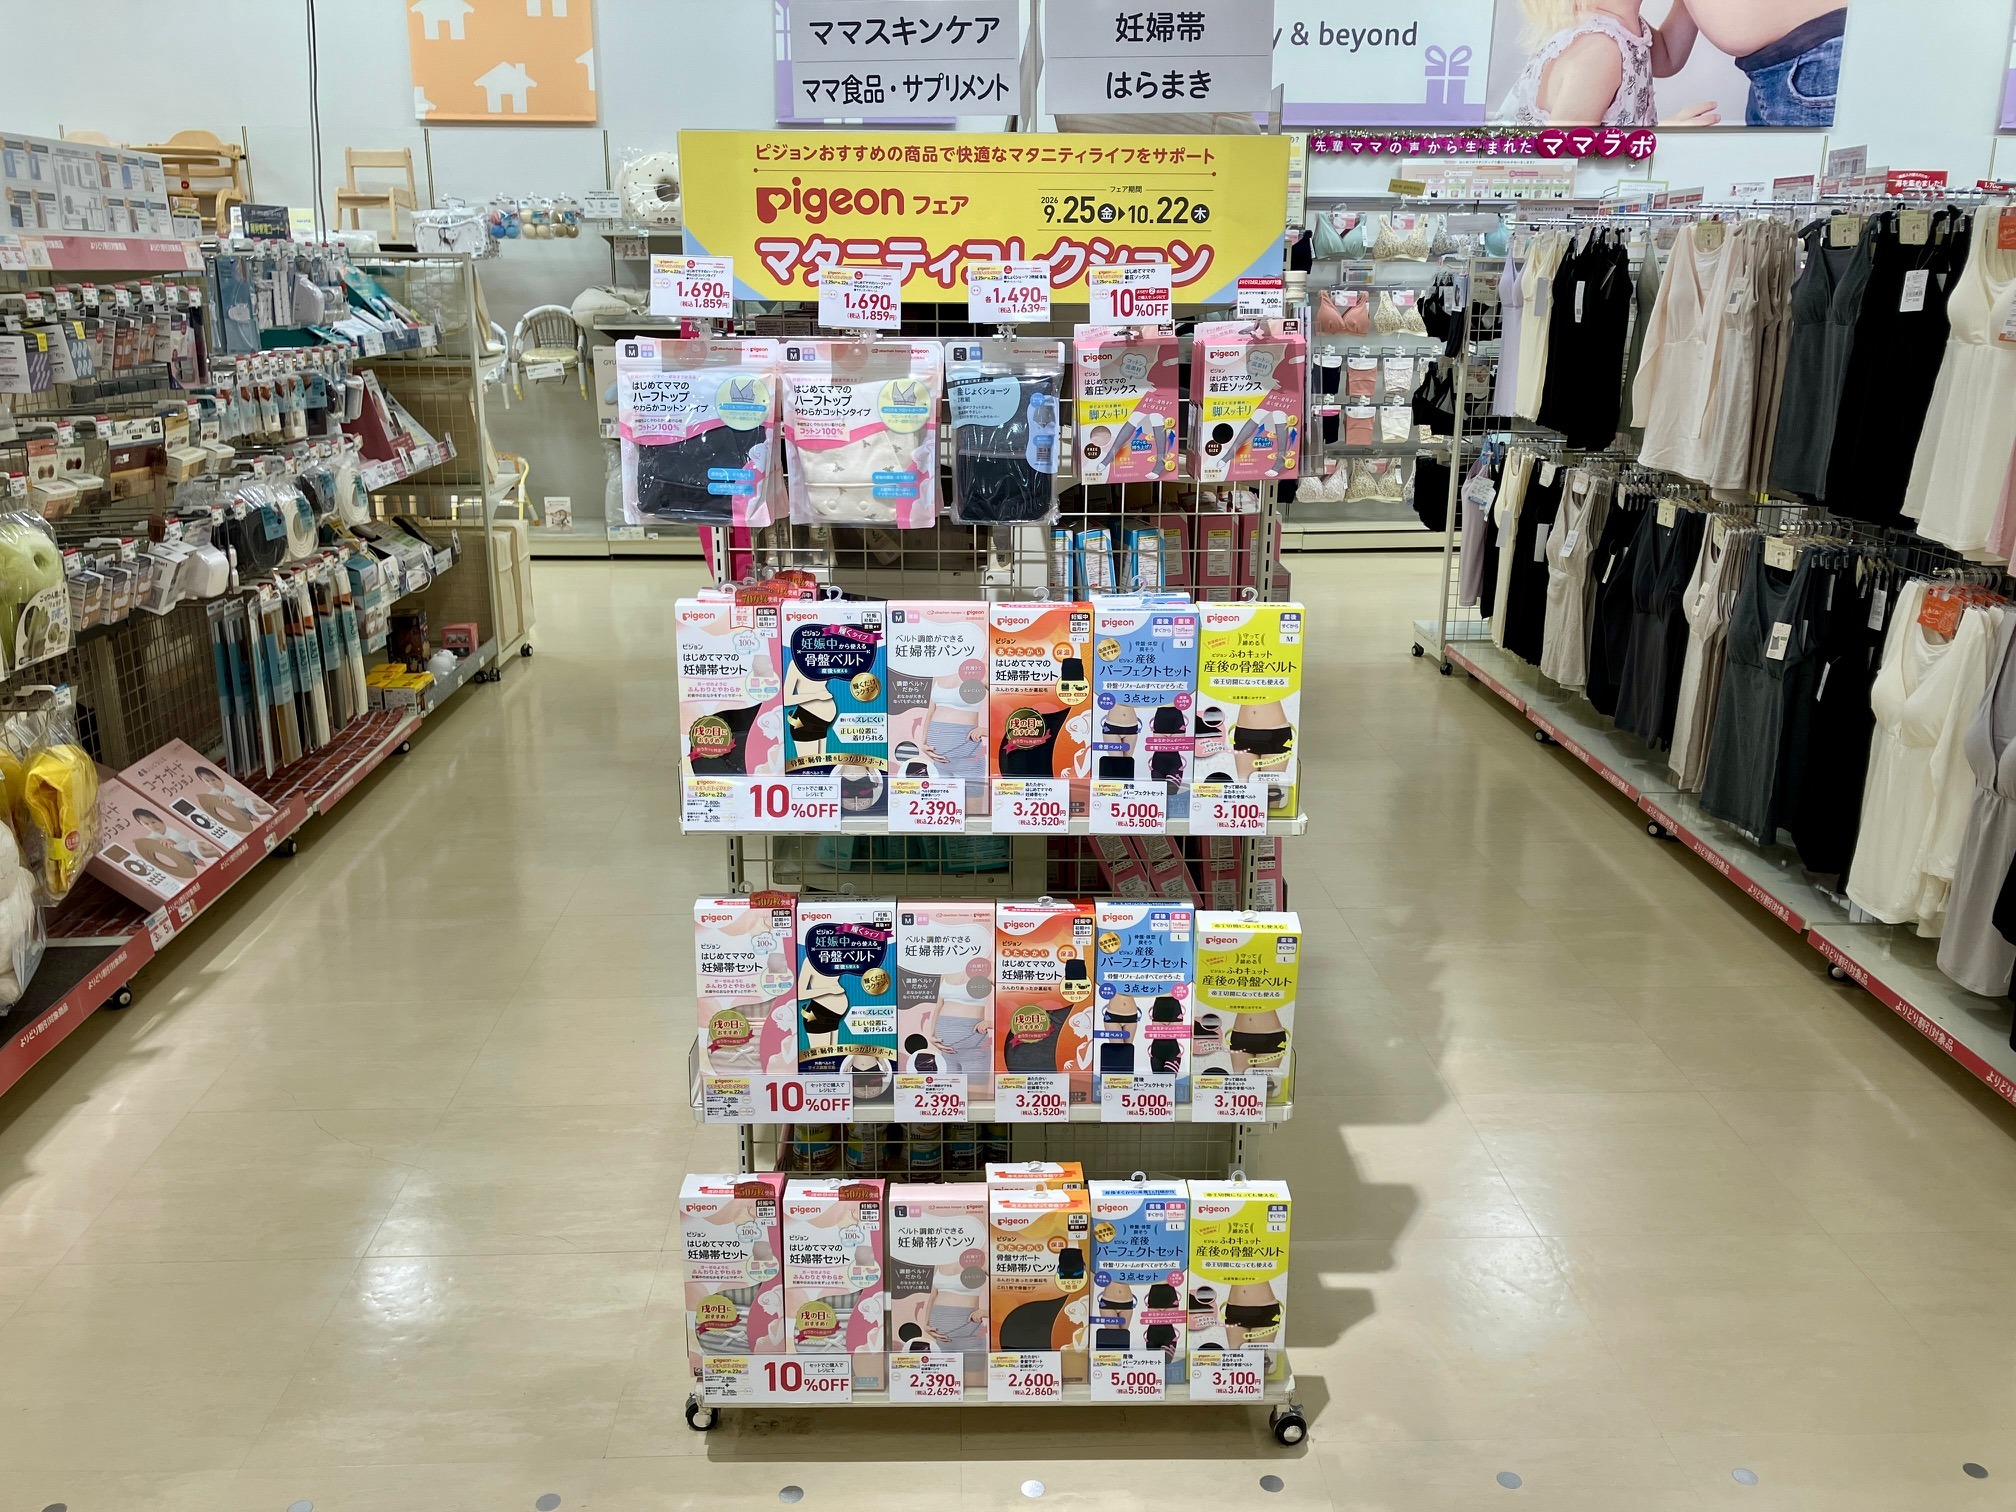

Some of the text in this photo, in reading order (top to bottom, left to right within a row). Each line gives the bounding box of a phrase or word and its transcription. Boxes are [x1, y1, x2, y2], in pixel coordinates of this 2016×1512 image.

[808, 15, 1000, 46] ママスキンケア
[1115, 12, 1206, 43] 妊婦帯
[1290, 21, 1309, 46] &
[1319, 21, 1418, 53] beyond
[802, 73, 1010, 104] ママ食品・サプリメント
[1105, 69, 1212, 101] はらまき
[1314, 132, 1655, 158] 先輩ママの声から生まれた ママラボ
[756, 143, 1215, 165] ピジョンおすすめの商品で快適なマタニティライフをサポート
[756, 176, 969, 224] pigeon フェア
[1041, 196, 1059, 204] 2026
[676, 281, 730, 298] 1,690円
[844, 293, 897, 311] 1,690円
[1209, 350, 1240, 360] pigeon
[1084, 377, 1127, 386] はじめてママの
[1209, 374, 1252, 382] はじめてママの
[632, 381, 690, 391] はじめてママの
[1084, 384, 1138, 396] 着圧ソックス
[1209, 381, 1263, 393] 着圧ソックス
[633, 391, 690, 403] ハーフトップ
[794, 395, 853, 407] ハーフトップ
[794, 408, 871, 417] やわらかコットンタイプ
[682, 612, 716, 621] pigeon
[785, 611, 819, 622] pigeon
[996, 616, 1030, 627] pigeon
[1206, 613, 1240, 624] pigeon
[1101, 618, 1135, 628] pigeon
[895, 644, 975, 658] 妊婦帯パンツ
[683, 653, 740, 663] はじめてママの
[804, 653, 865, 667] 骨盤ベルト
[995, 659, 1051, 668] はじめてママの
[683, 664, 748, 676] 妊婦帯セット
[1099, 664, 1192, 678] パーフェクトセット
[1203, 659, 1298, 674] 産後の骨盤ベルト
[995, 669, 1059, 682] 妊婦帯セット
[1123, 693, 1166, 704] 3点セット
[908, 800, 963, 816] 2,390円
[1013, 801, 1067, 817] 3,200円
[1110, 803, 1165, 819] 5,000円
[1213, 804, 1266, 819] 3,100円
[701, 913, 733, 924] pigeon
[1102, 913, 1134, 923] pigeon
[1003, 920, 1036, 930] pigeon
[1205, 936, 1238, 946] pigeon
[701, 952, 755, 961] はじめてママの
[818, 950, 876, 964] 骨盤ベルト
[904, 944, 982, 958] 妊婦帯パンツ
[701, 962, 764, 974] 妊婦帯セット
[1001, 959, 1056, 968] はじめてママの
[1100, 956, 1188, 969] パーフェクトセット
[1201, 976, 1293, 988] 産後の骨盤ベルト
[914, 1094, 966, 1109] 2,390円
[1015, 1094, 1067, 1109] 3,200円
[1121, 1094, 1173, 1109] 5,000円
[1214, 1094, 1264, 1109] 3,100円
[686, 1204, 718, 1213] pigeon
[789, 1206, 821, 1215] pigeon
[1097, 1203, 1129, 1213] pigeon
[1198, 1205, 1230, 1214] pigeon
[997, 1216, 1029, 1226] pigeon
[686, 1240, 740, 1249] はじめてママの
[789, 1243, 843, 1252] はじめてママの
[897, 1236, 975, 1249] 妊婦帯パンツ
[1096, 1245, 1184, 1258] パーフェクトセット
[1195, 1245, 1285, 1258] 産後の骨盤ベルト
[909, 1374, 961, 1388] 2,390円
[1008, 1373, 1060, 1388] 2,600円
[1110, 1372, 1163, 1387] 5,000円
[1212, 1372, 1261, 1387] 3,100円
